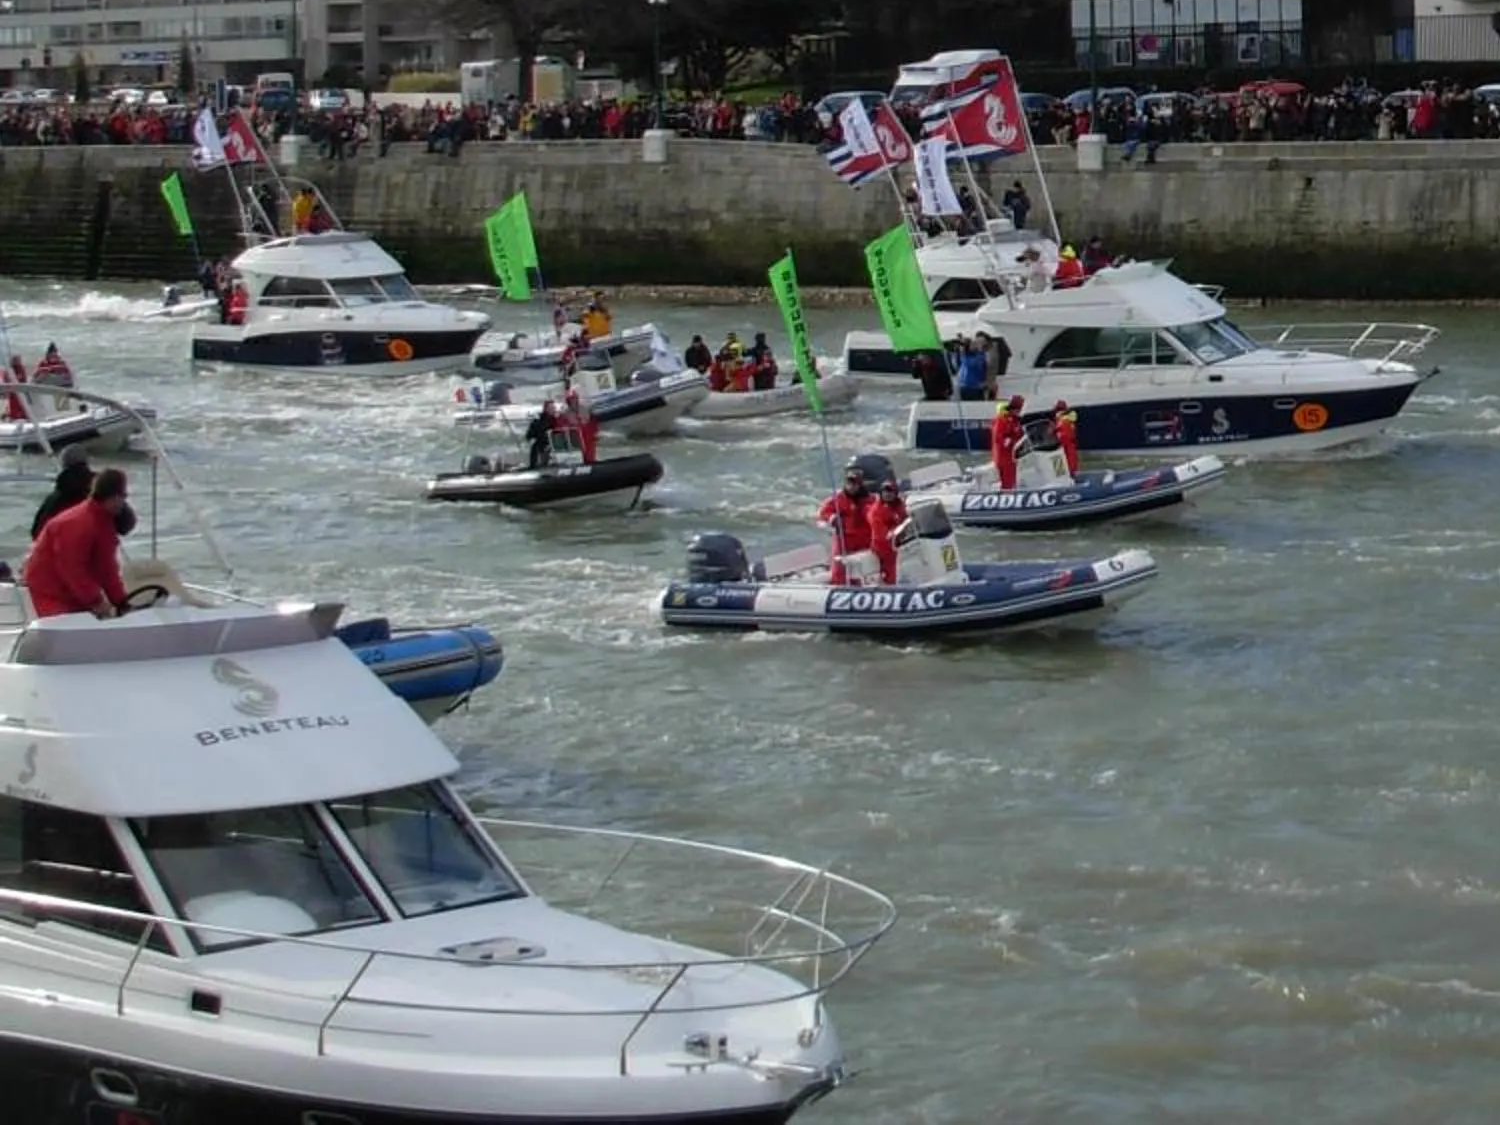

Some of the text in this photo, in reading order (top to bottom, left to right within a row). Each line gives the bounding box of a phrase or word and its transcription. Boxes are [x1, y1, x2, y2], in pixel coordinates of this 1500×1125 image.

[1303, 406, 1322, 426] 15
[965, 491, 1057, 510] ZODIAC
[830, 589, 945, 612] ZODIAC
[195, 714, 350, 746] BENETEAU
